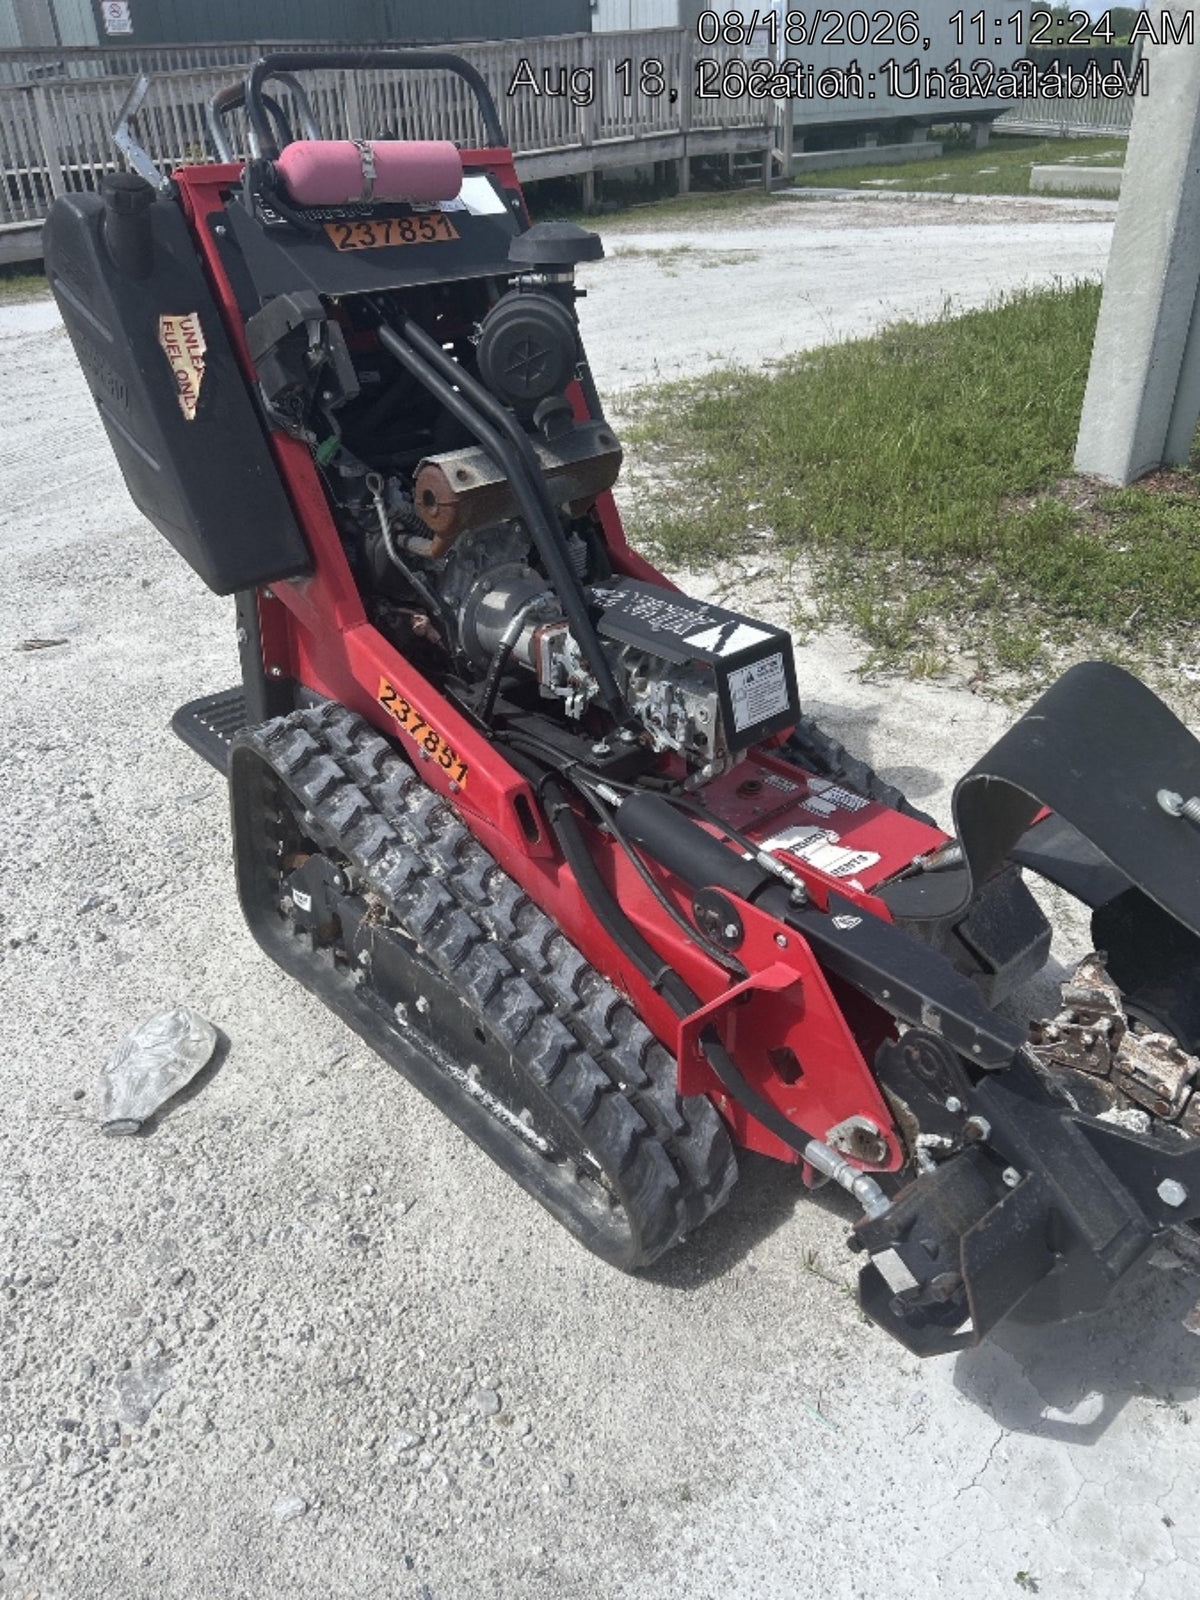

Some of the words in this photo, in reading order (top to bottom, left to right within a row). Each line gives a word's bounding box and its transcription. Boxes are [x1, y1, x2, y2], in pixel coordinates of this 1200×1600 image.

[335, 216, 454, 249] 237851
[163, 321, 183, 366] FUEL
[380, 685, 469, 782] 237851
